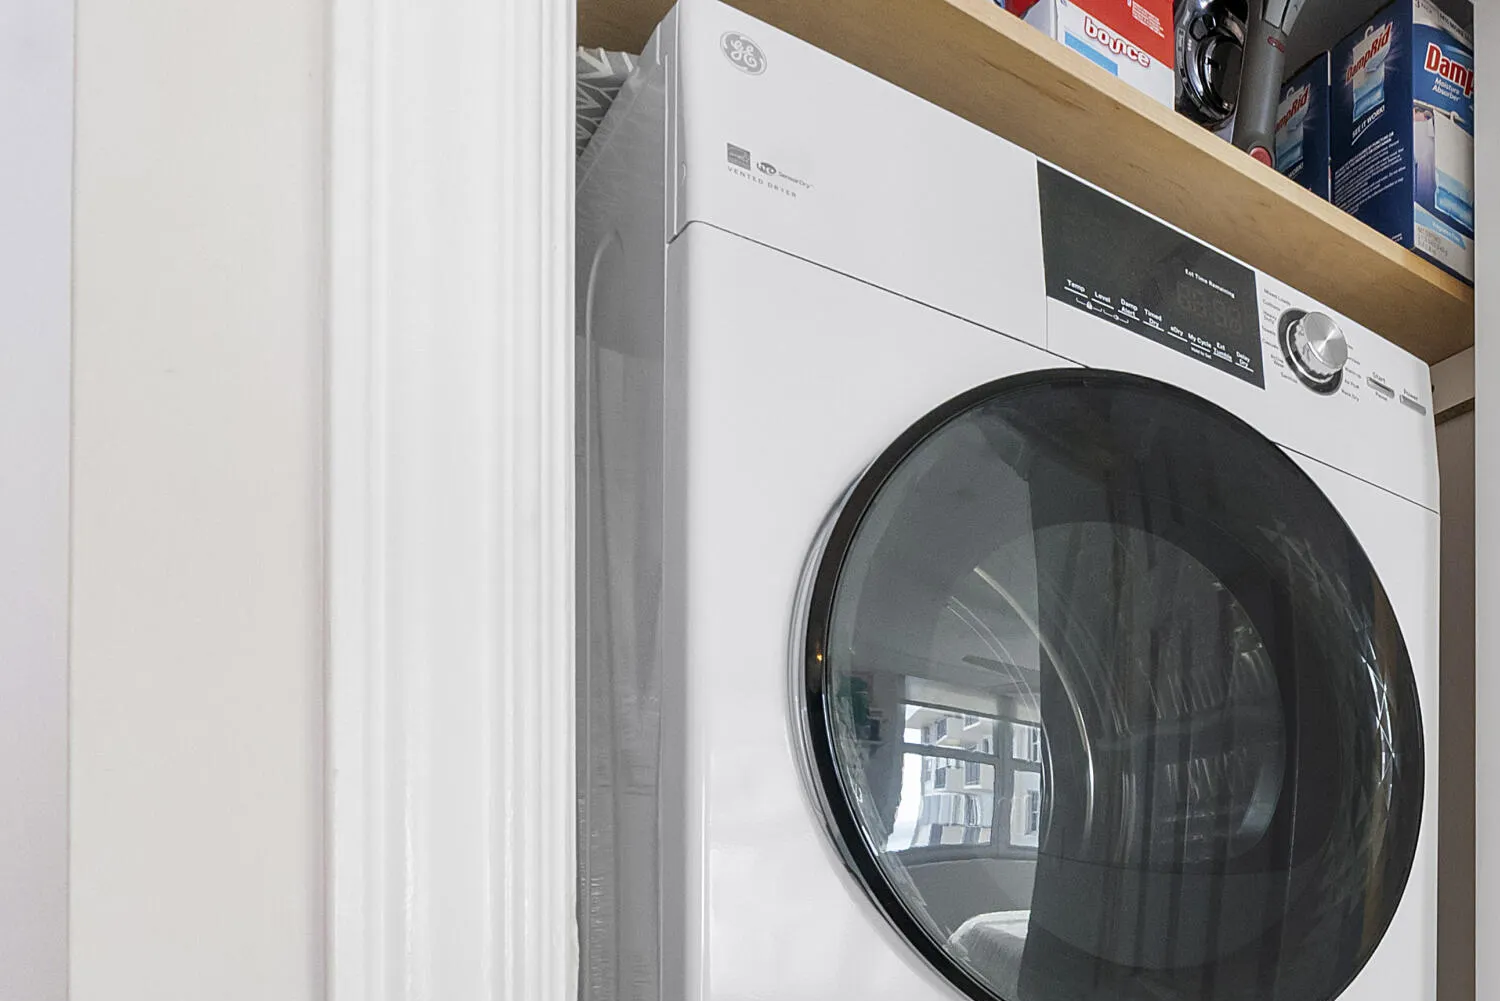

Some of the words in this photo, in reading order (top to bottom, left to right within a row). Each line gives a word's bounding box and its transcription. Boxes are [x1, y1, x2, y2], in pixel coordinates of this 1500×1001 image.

[725, 34, 763, 72] GE
[1084, 16, 1150, 68] bounce
[1345, 21, 1393, 84] DampRid
[1424, 42, 1474, 98] Damp
[1432, 86, 1461, 102] Absorber
[1434, 77, 1460, 95] Moisture
[728, 166, 764, 185] VENTED
[767, 182, 797, 198] DRYER
[1066, 279, 1086, 293] Temp
[1184, 268, 1195, 278] Est
[1195, 272, 1208, 285] Time
[1208, 280, 1236, 299] Remaining
[1094, 291, 1111, 303] Level
[1120, 298, 1139, 312] Damp
[1187, 332, 1197, 343] My
[1196, 337, 1212, 349] Cycle
